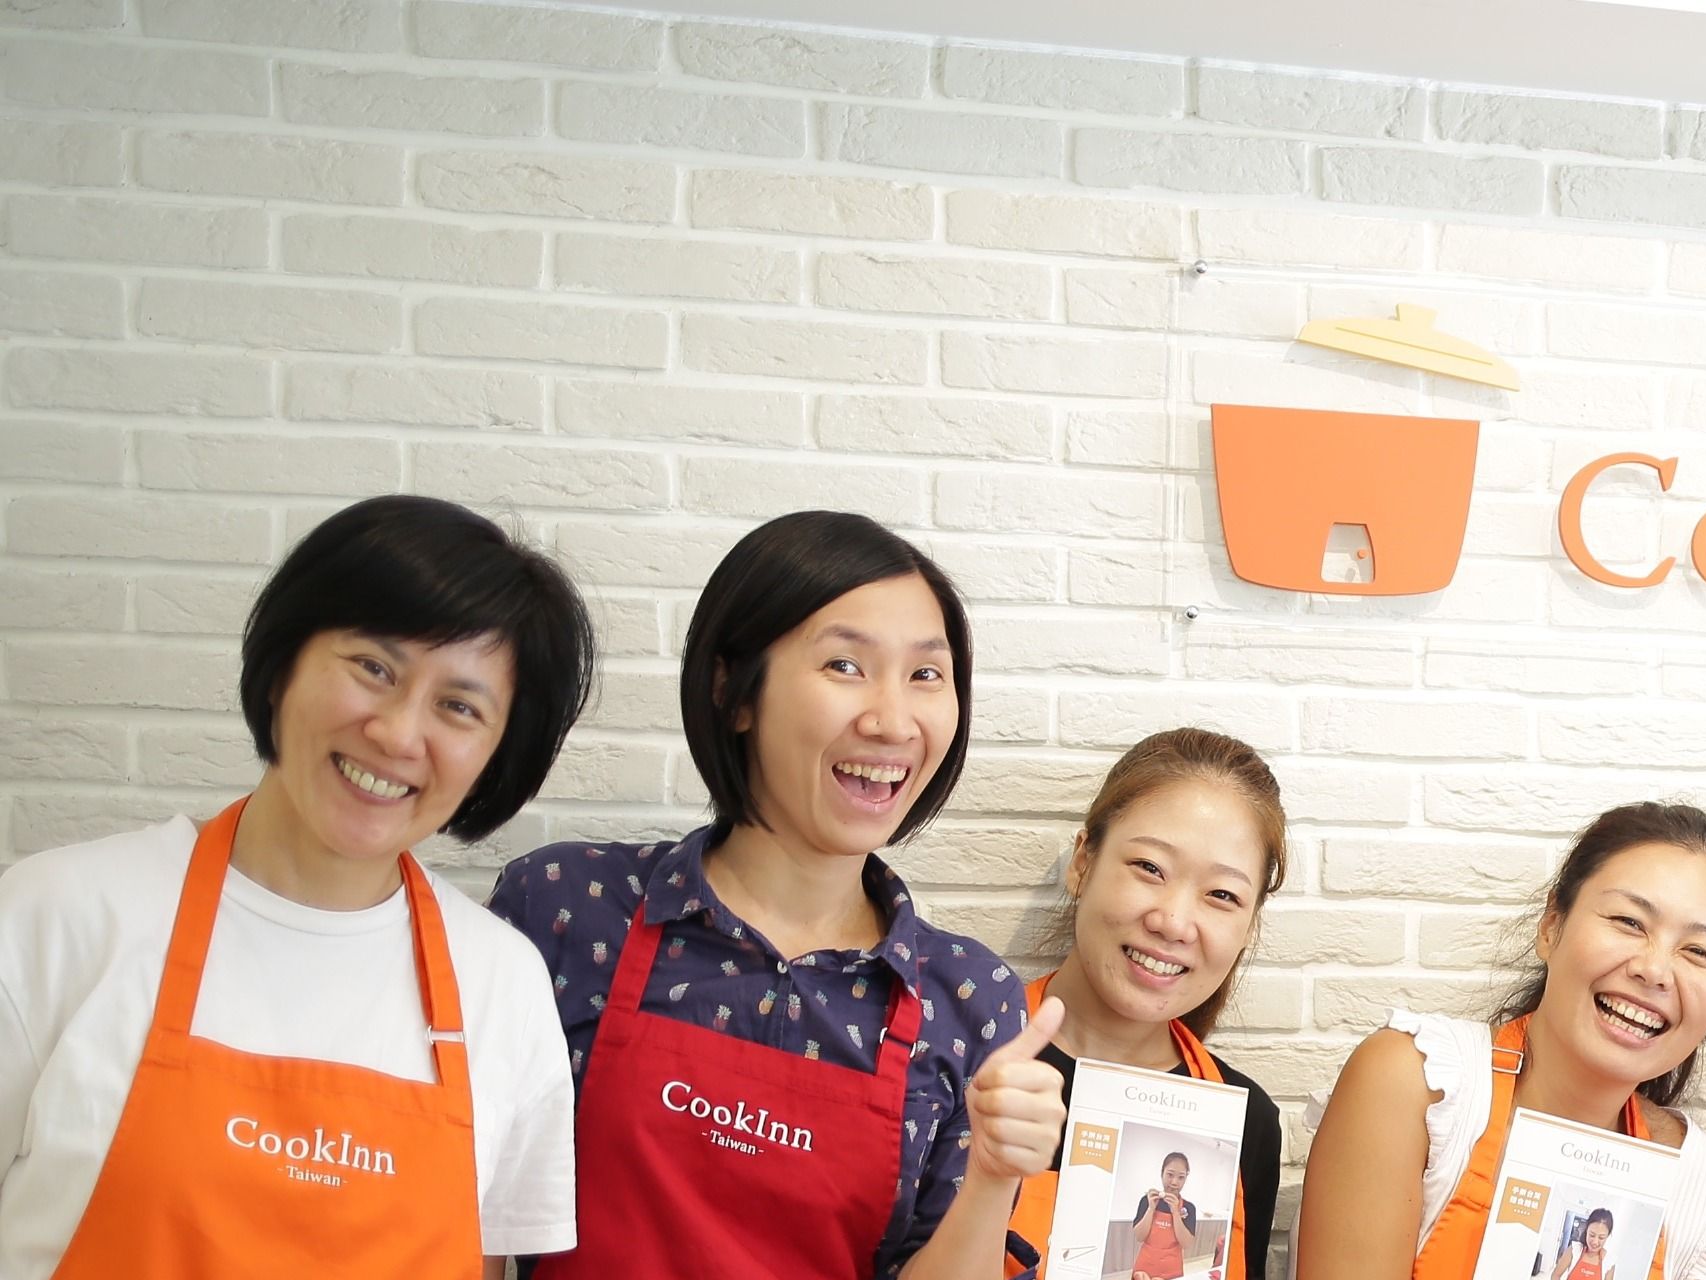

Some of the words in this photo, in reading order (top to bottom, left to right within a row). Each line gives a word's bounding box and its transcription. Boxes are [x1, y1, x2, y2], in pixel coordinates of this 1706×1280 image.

[661, 1080, 813, 1152] CookInn
[1124, 1086, 1198, 1112] CookInn
[225, 1117, 396, 1175] CookInn
[1560, 1142, 1631, 1173] CookInn
